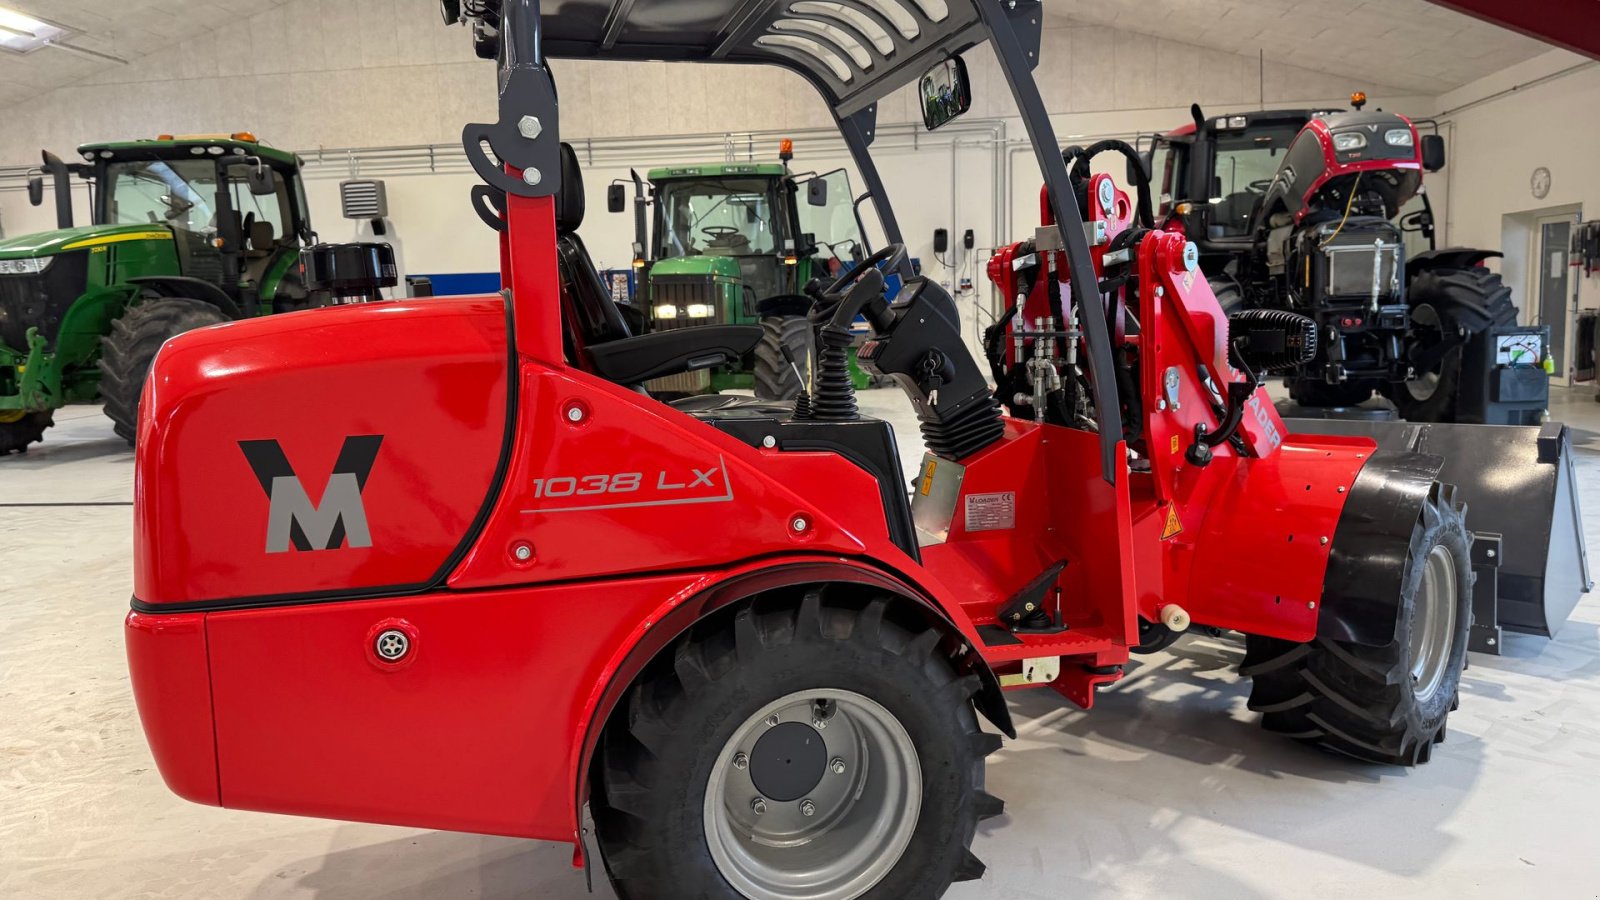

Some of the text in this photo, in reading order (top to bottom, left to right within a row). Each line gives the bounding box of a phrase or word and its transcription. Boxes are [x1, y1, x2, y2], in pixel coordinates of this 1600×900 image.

[1245, 390, 1281, 449] ADER
[533, 467, 719, 498] 1038 LX
